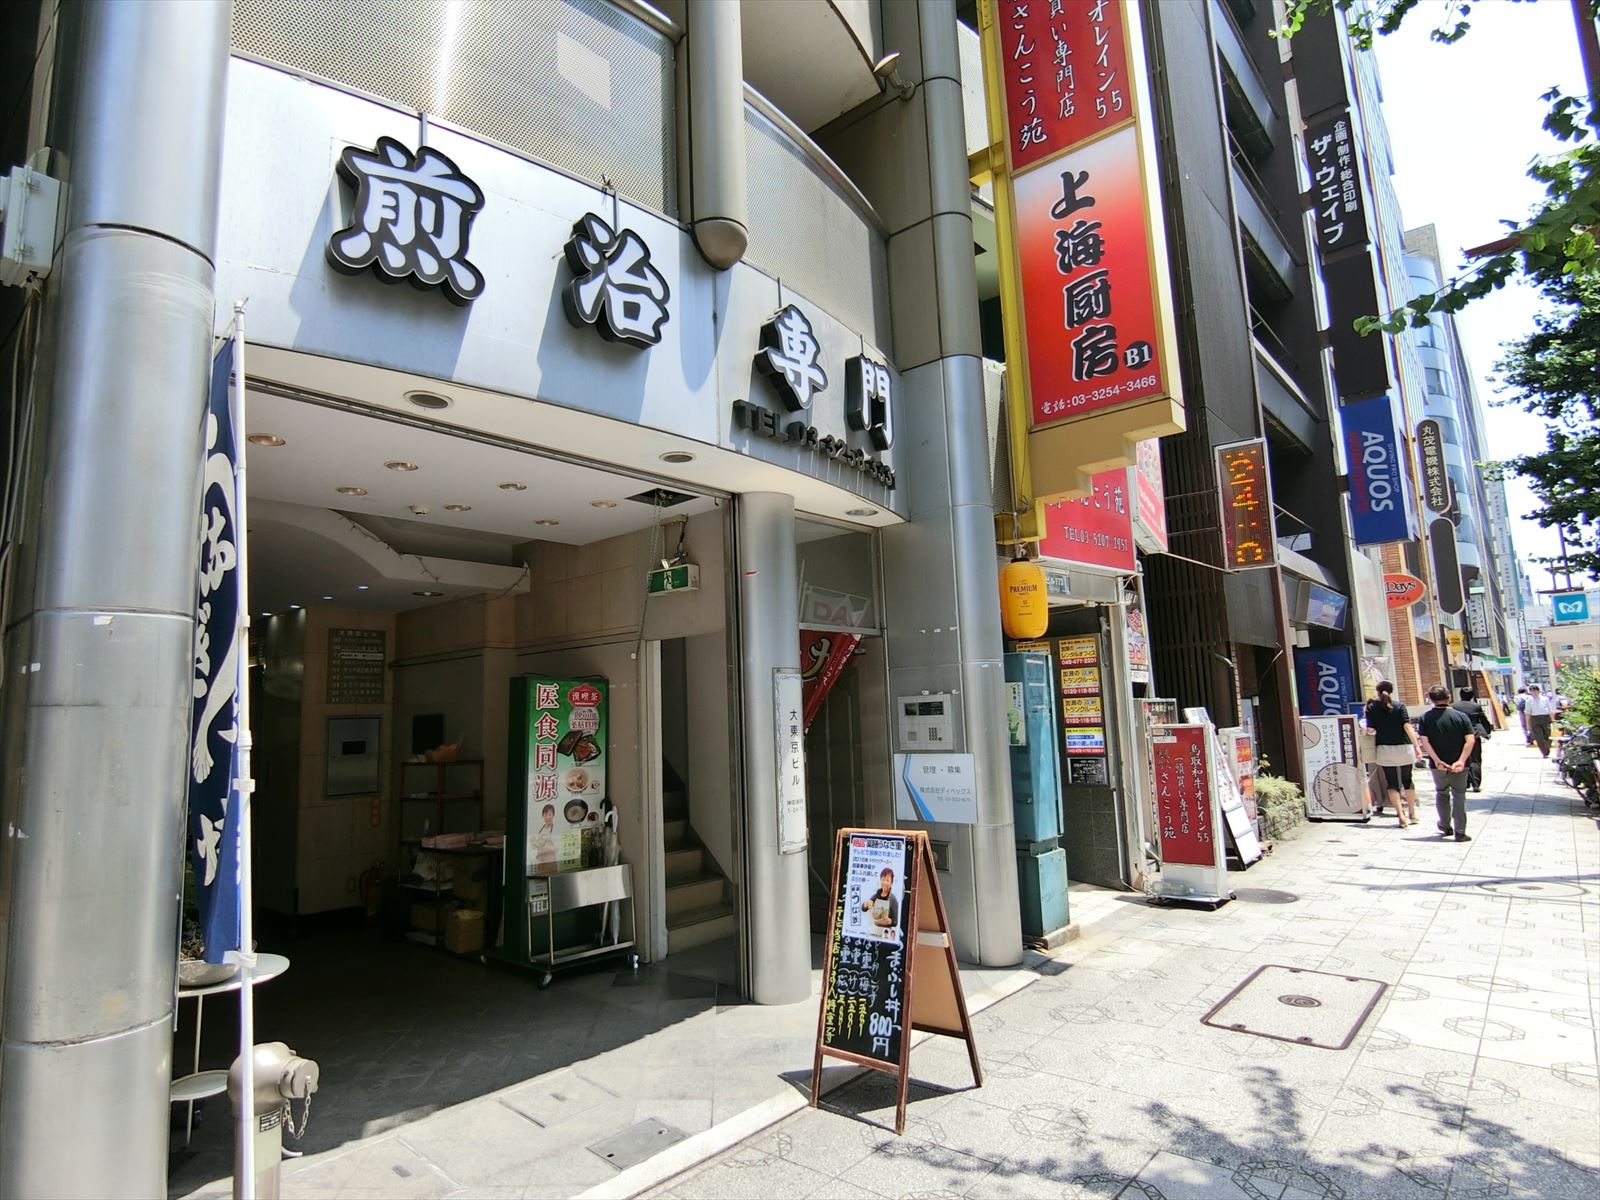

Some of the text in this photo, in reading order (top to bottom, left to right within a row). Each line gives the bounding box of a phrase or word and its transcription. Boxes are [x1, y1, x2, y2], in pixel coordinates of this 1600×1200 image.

[1050, 170, 1119, 382] 上海厨房
[1124, 345, 1151, 368] B1
[1361, 430, 1394, 512] AQUOS
[1421, 425, 1444, 507] 丸茂電機株式会社
[1009, 584, 1038, 594] PREMIUM
[1063, 676, 1098, 684] トランクルーム
[533, 682, 560, 802] 医食同源
[789, 708, 801, 786] 大東京ビル
[1190, 743, 1210, 843] 鳥取和牛オレイン55
